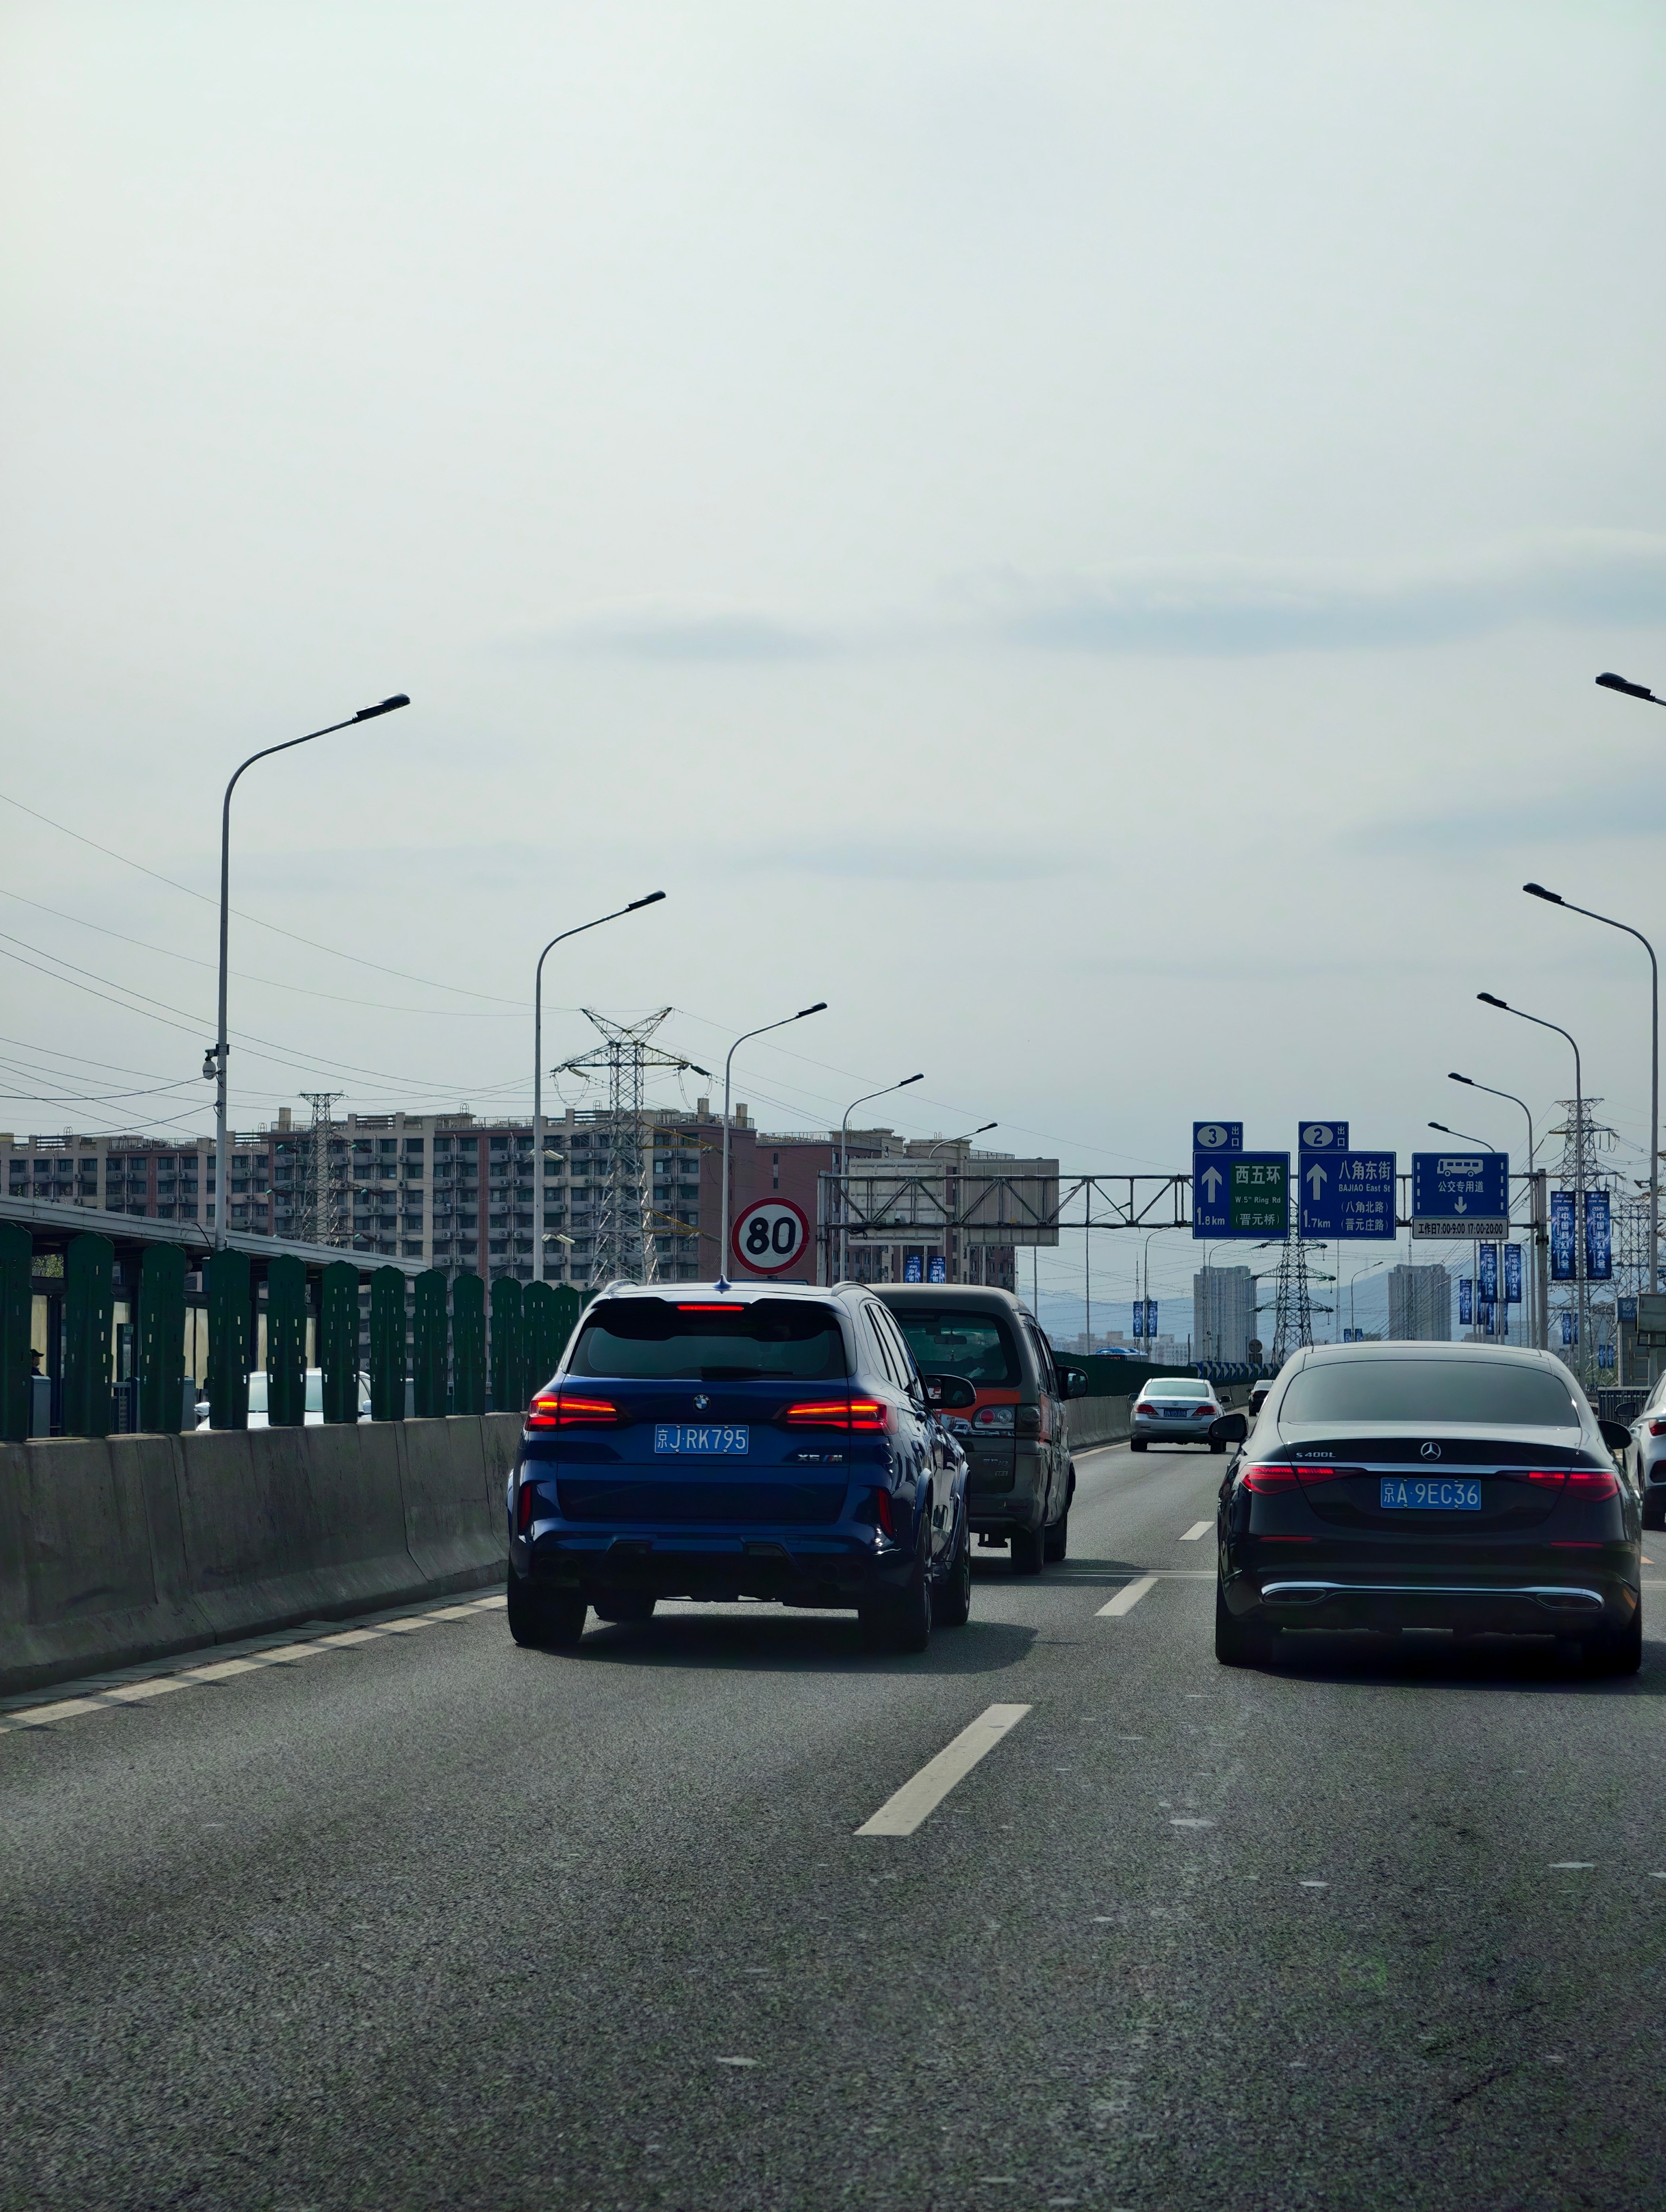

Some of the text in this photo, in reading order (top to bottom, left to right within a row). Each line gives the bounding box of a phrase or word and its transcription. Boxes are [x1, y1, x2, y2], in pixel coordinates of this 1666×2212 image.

[1208, 1128, 1217, 1144] 3
[1231, 1126, 1239, 1147] 出口
[1313, 1128, 1323, 1144] 2
[1337, 1126, 1345, 1147] 出口
[1235, 1166, 1281, 1185] 西五环
[1338, 1160, 1391, 1180] 八角东街
[1338, 1184, 1391, 1193] BAJIAO East St
[1438, 1180, 1484, 1193] 公交专用道
[1254, 1197, 1269, 1205] Ring
[1341, 1200, 1388, 1213] (八角北路)
[1235, 1213, 1280, 1226] (晋元桥)
[1341, 1218, 1388, 1231] (晋元庄路)
[746, 1217, 796, 1255] 80
[1560, 1212, 1569, 1269] 中国科幻大会
[1596, 1212, 1606, 1269] 中国科幻大会
[1383, 1483, 1478, 1504] 京A·9EC36
